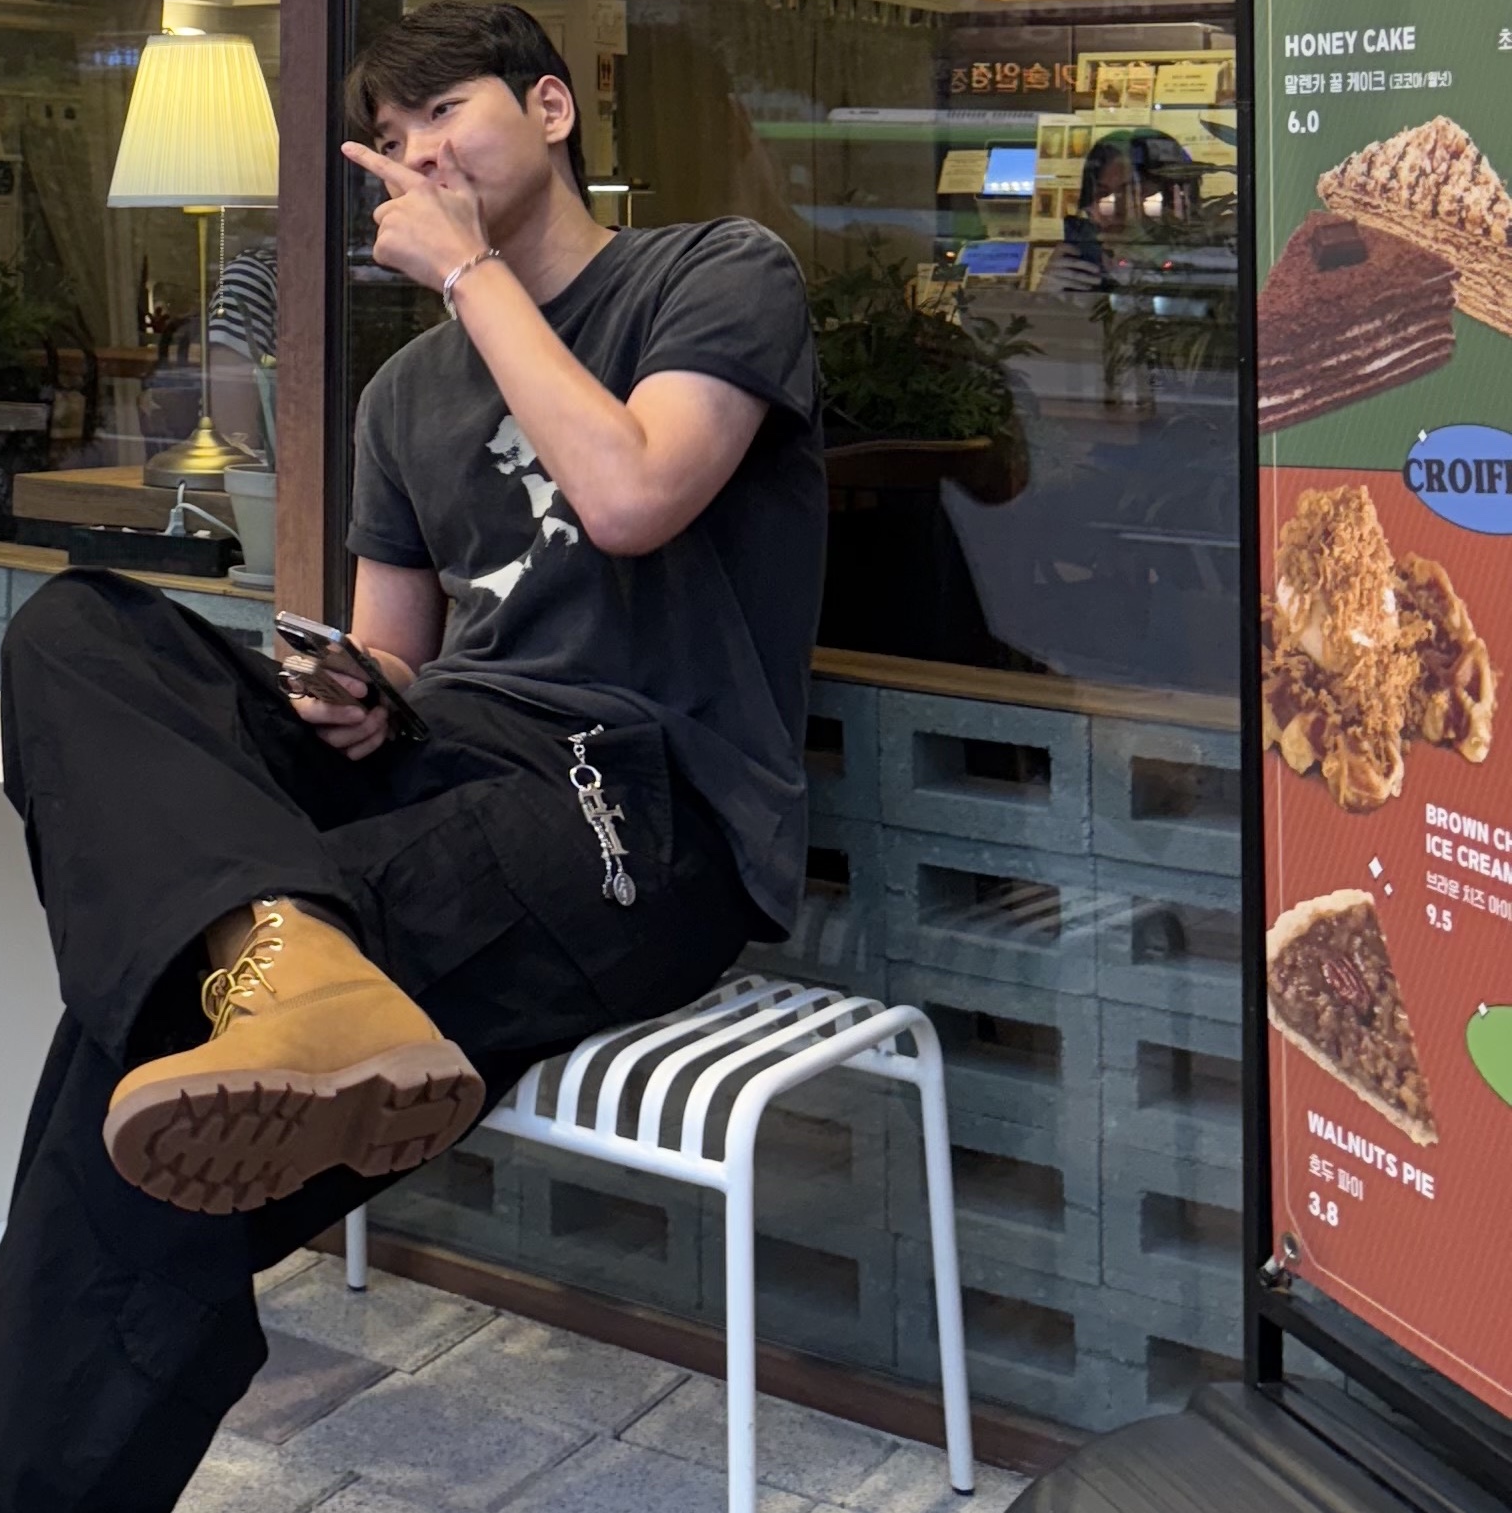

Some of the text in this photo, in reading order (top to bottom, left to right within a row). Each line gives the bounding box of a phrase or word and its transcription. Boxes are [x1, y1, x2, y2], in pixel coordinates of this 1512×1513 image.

[1285, 26, 1416, 57] HONEY CAKE
[1284, 73, 1326, 95] 말렌카
[1329, 73, 1343, 93] 꿀
[1346, 71, 1386, 92] 케이크
[1288, 110, 1320, 134] 6.0
[1425, 803, 1489, 845] BROWN
[1425, 833, 1454, 862] ICE
[1426, 869, 1460, 900] 브라운
[1462, 884, 1486, 910] 치즈
[1425, 902, 1454, 933] 9.5
[1307, 1110, 1436, 1200] WALNUTS PIE
[1308, 1152, 1364, 1202] 호두 파이
[1308, 1190, 1339, 1227] 3.8
